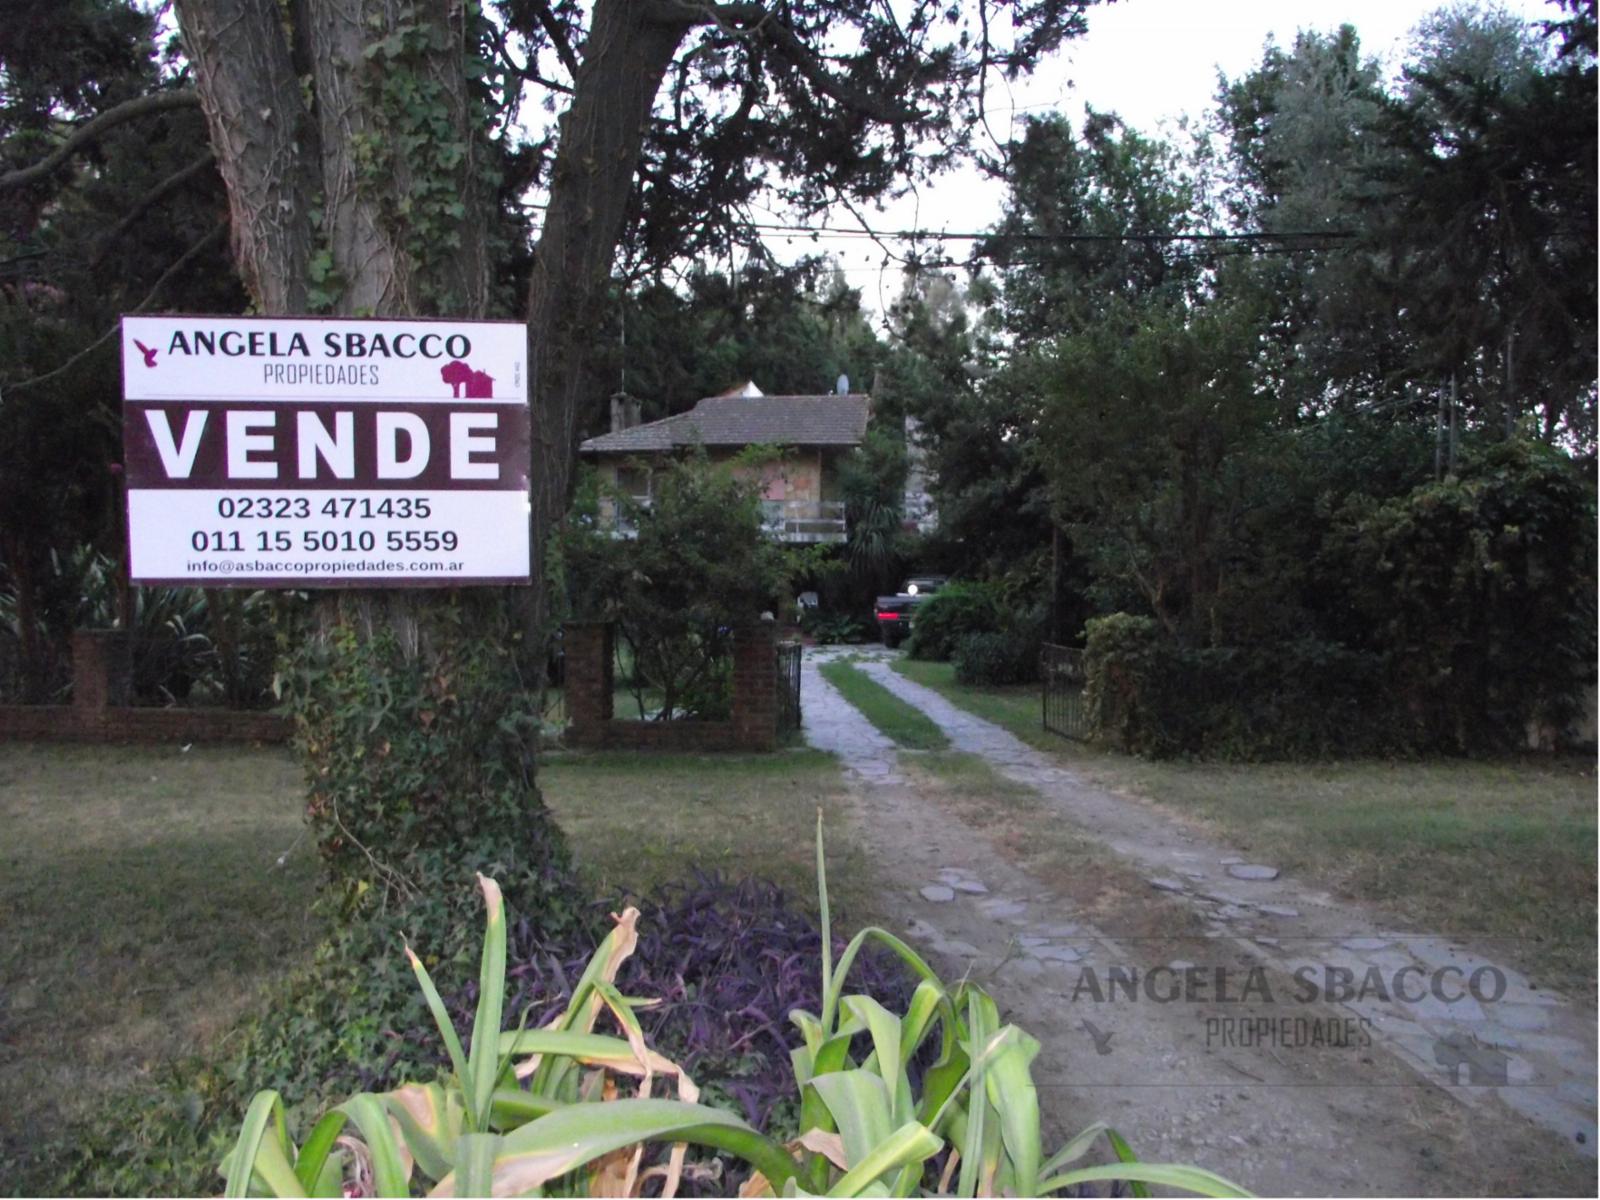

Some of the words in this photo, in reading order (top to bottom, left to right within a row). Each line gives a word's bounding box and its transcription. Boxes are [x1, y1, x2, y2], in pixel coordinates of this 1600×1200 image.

[168, 330, 311, 357] ANGELA
[324, 331, 472, 359] SBACCO
[263, 364, 379, 386] PROPIEDADES
[144, 409, 500, 481] VENDE
[218, 497, 310, 519] 02323
[321, 497, 431, 519] 471435
[191, 530, 245, 552] 011
[256, 530, 292, 552] 15
[303, 530, 376, 552] 5010
[387, 530, 459, 552] 5559
[186, 559, 465, 575] info@asbaccopropiedades.com.ar
